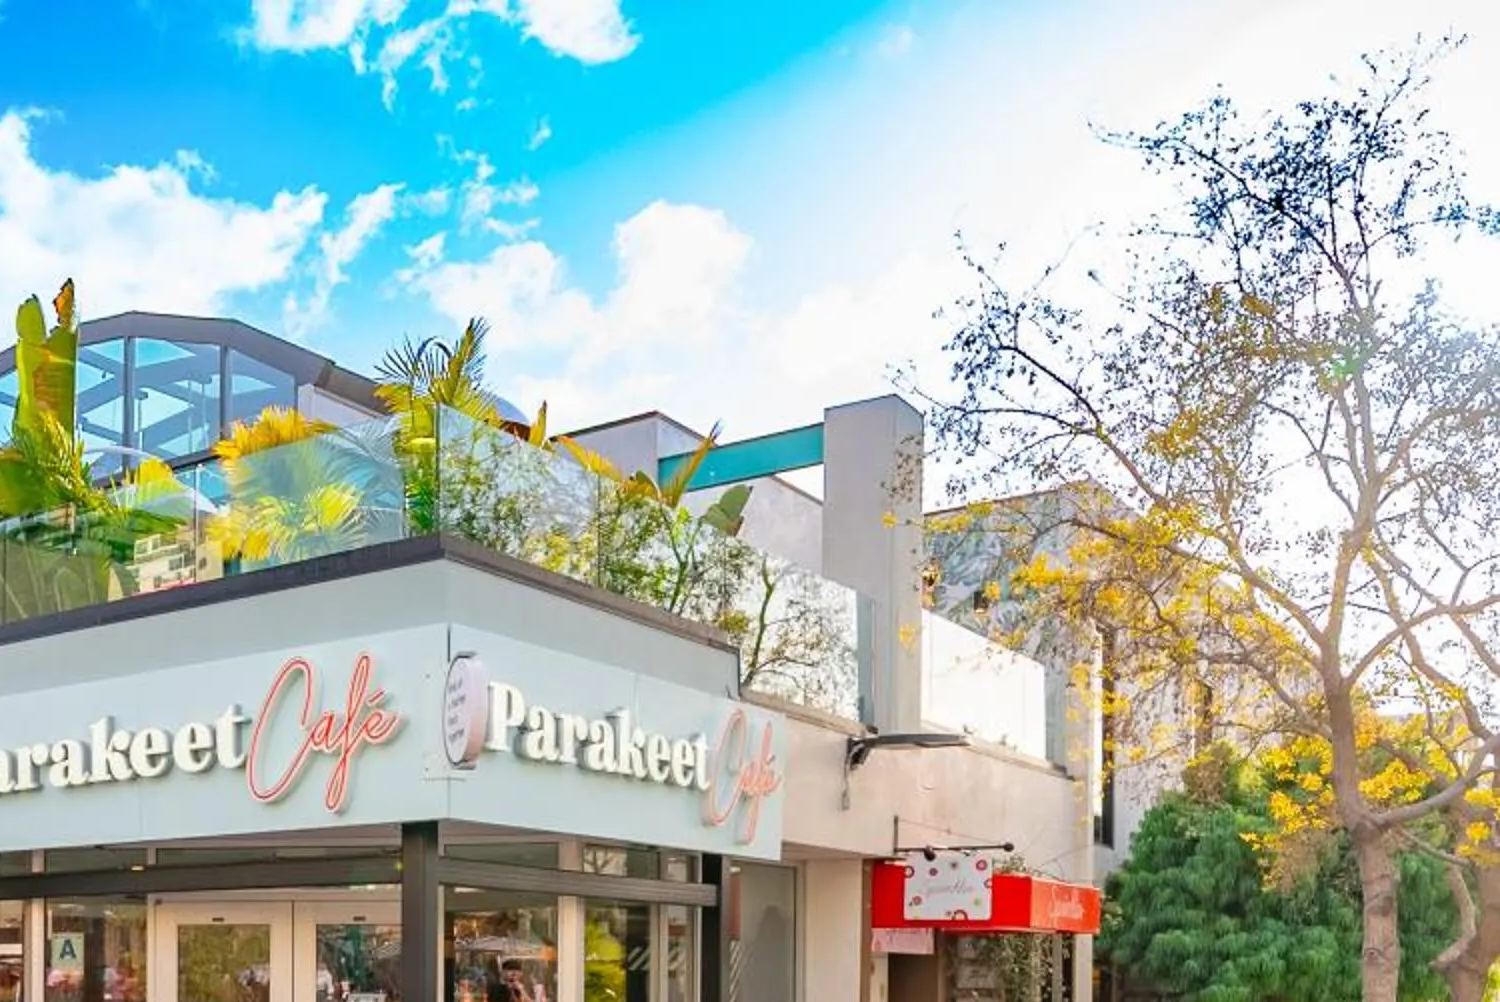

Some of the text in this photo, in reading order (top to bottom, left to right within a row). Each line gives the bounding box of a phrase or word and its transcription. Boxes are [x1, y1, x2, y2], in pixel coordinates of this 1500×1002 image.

[246, 650, 401, 813] Café
[486, 680, 711, 791] Parakeet
[707, 708, 784, 845] Café
[59, 938, 77, 960] A
